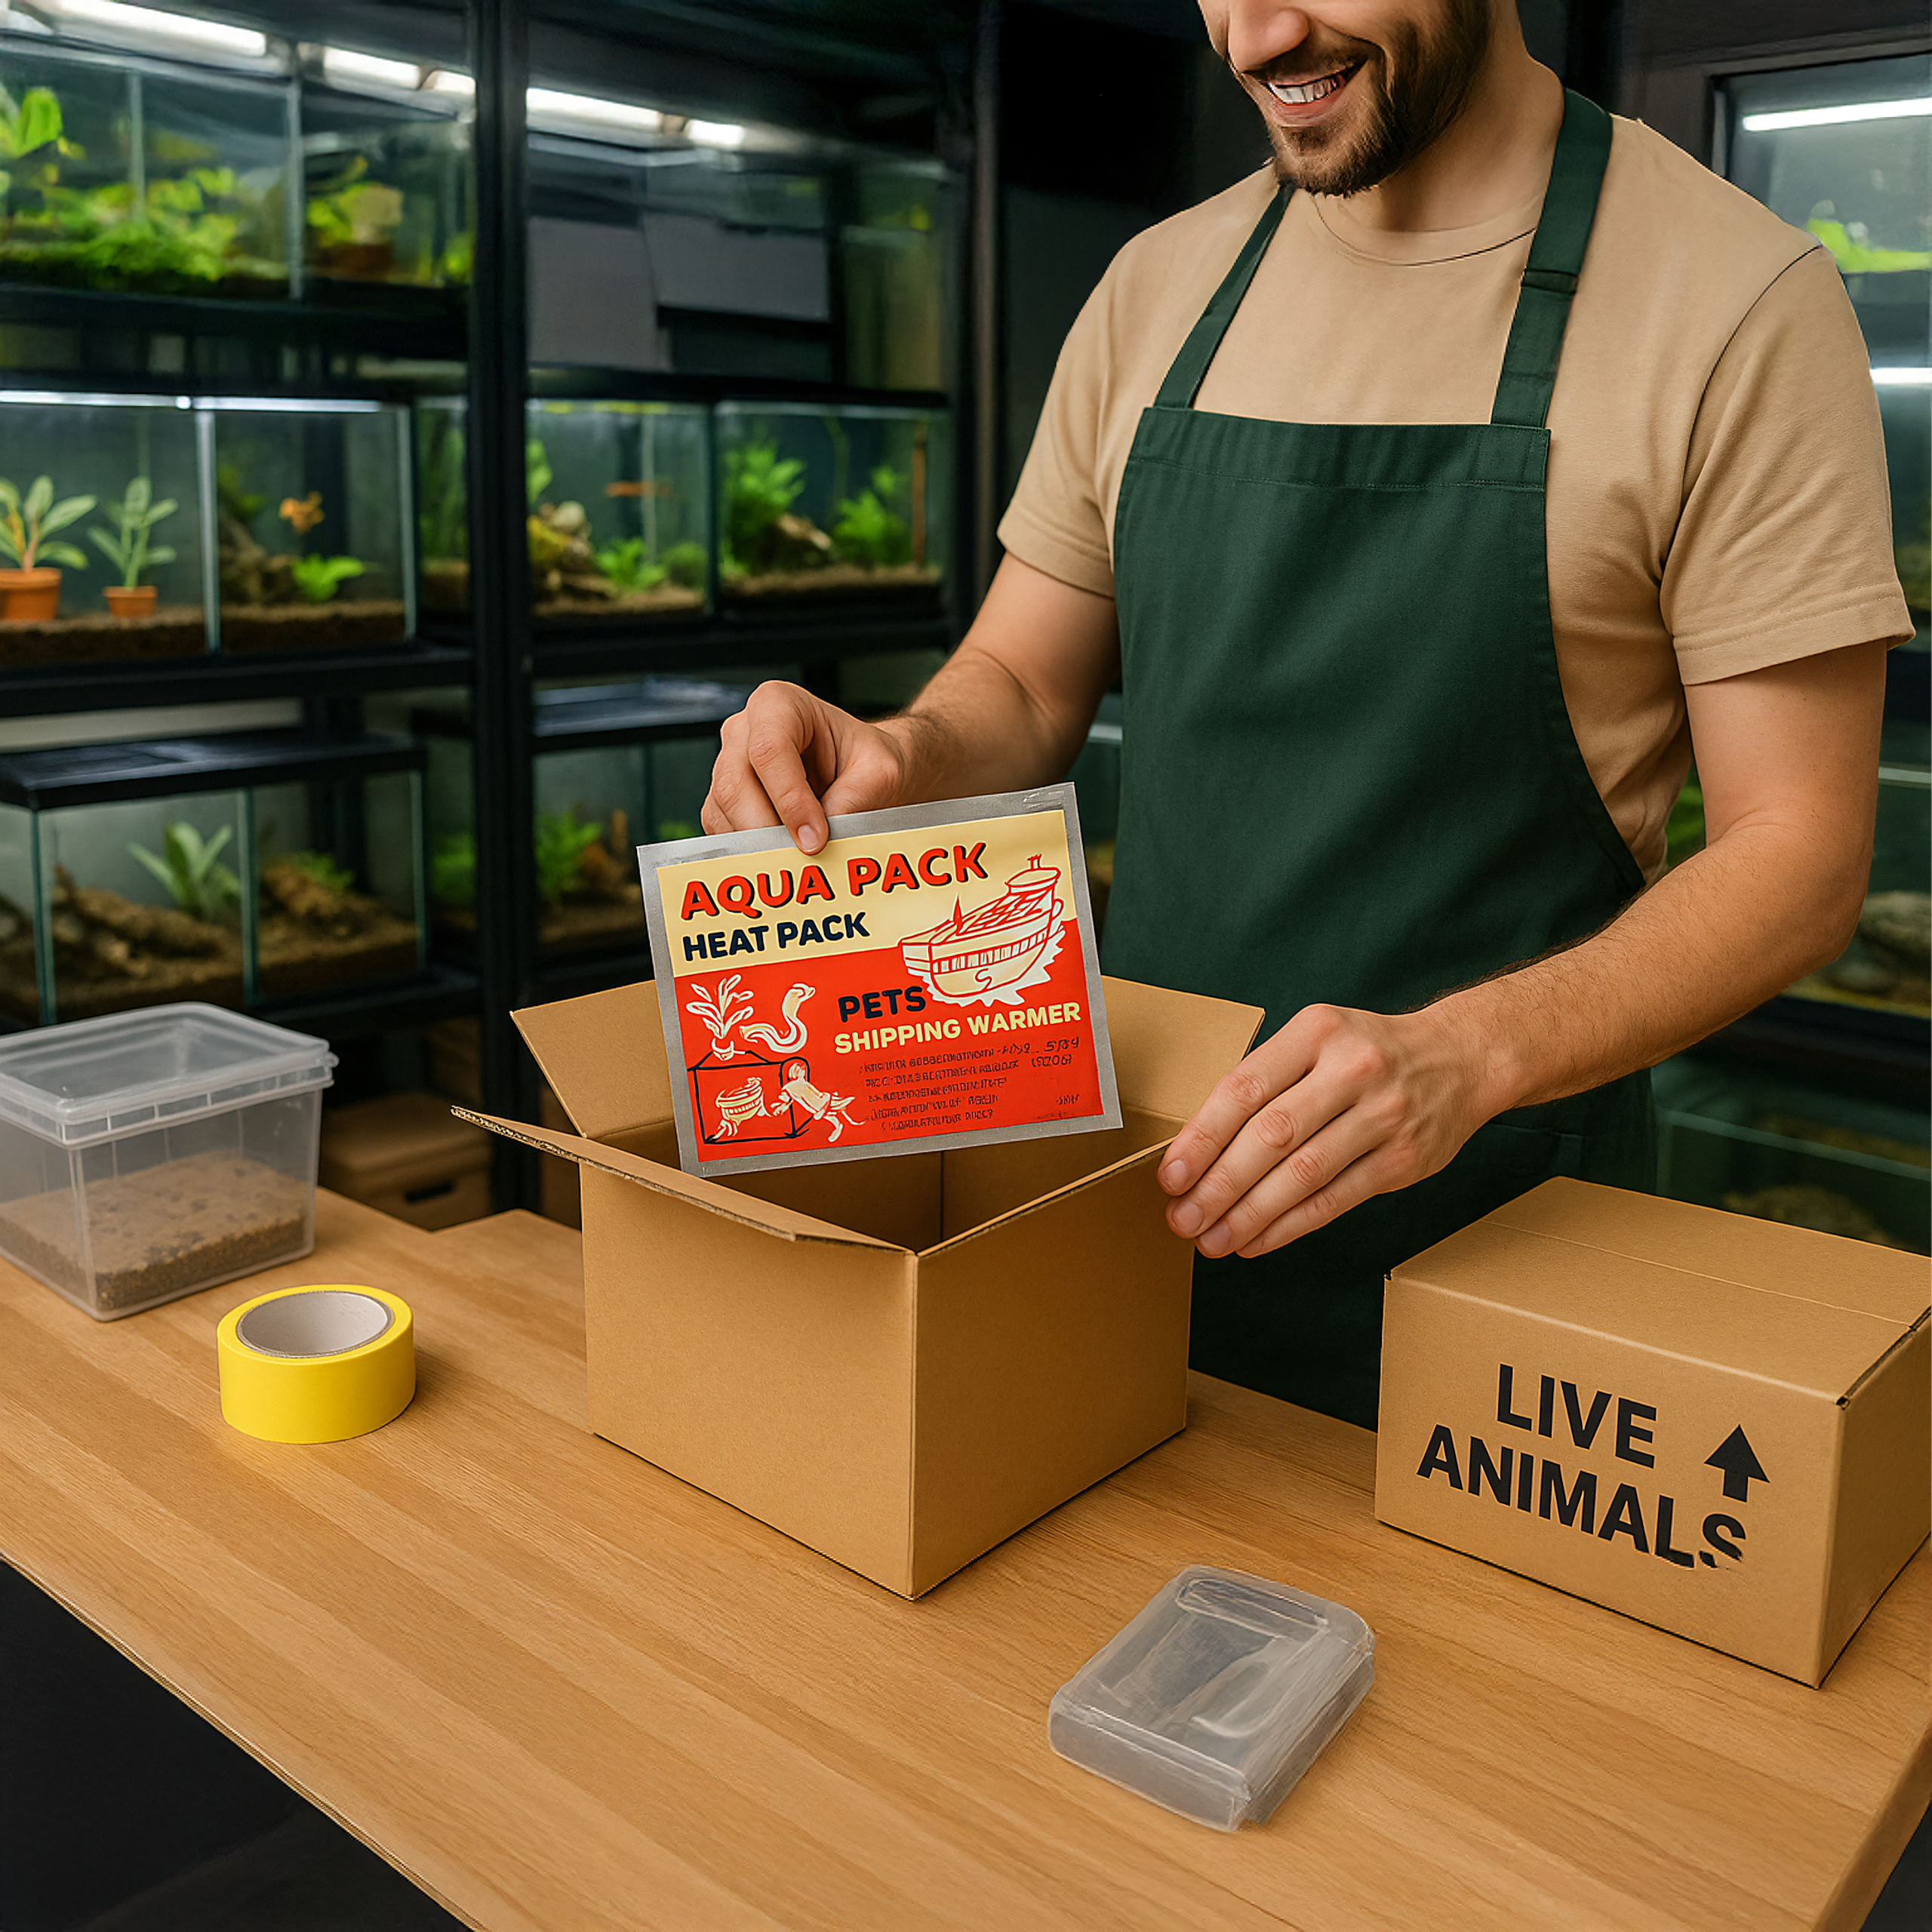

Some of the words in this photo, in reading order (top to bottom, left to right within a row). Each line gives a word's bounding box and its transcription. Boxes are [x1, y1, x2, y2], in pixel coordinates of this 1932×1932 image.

[680, 864, 835, 921] AQUA
[847, 841, 989, 897] PACK
[682, 925, 768, 961] HEAT
[777, 912, 870, 949] PACK
[834, 1018, 961, 1054] SHIPPING
[968, 1001, 1081, 1035] WARMER
[838, 986, 927, 1023] PETS
[1497, 1363, 1657, 1469] LIVE
[1416, 1423, 1746, 1570] ANIMALS
